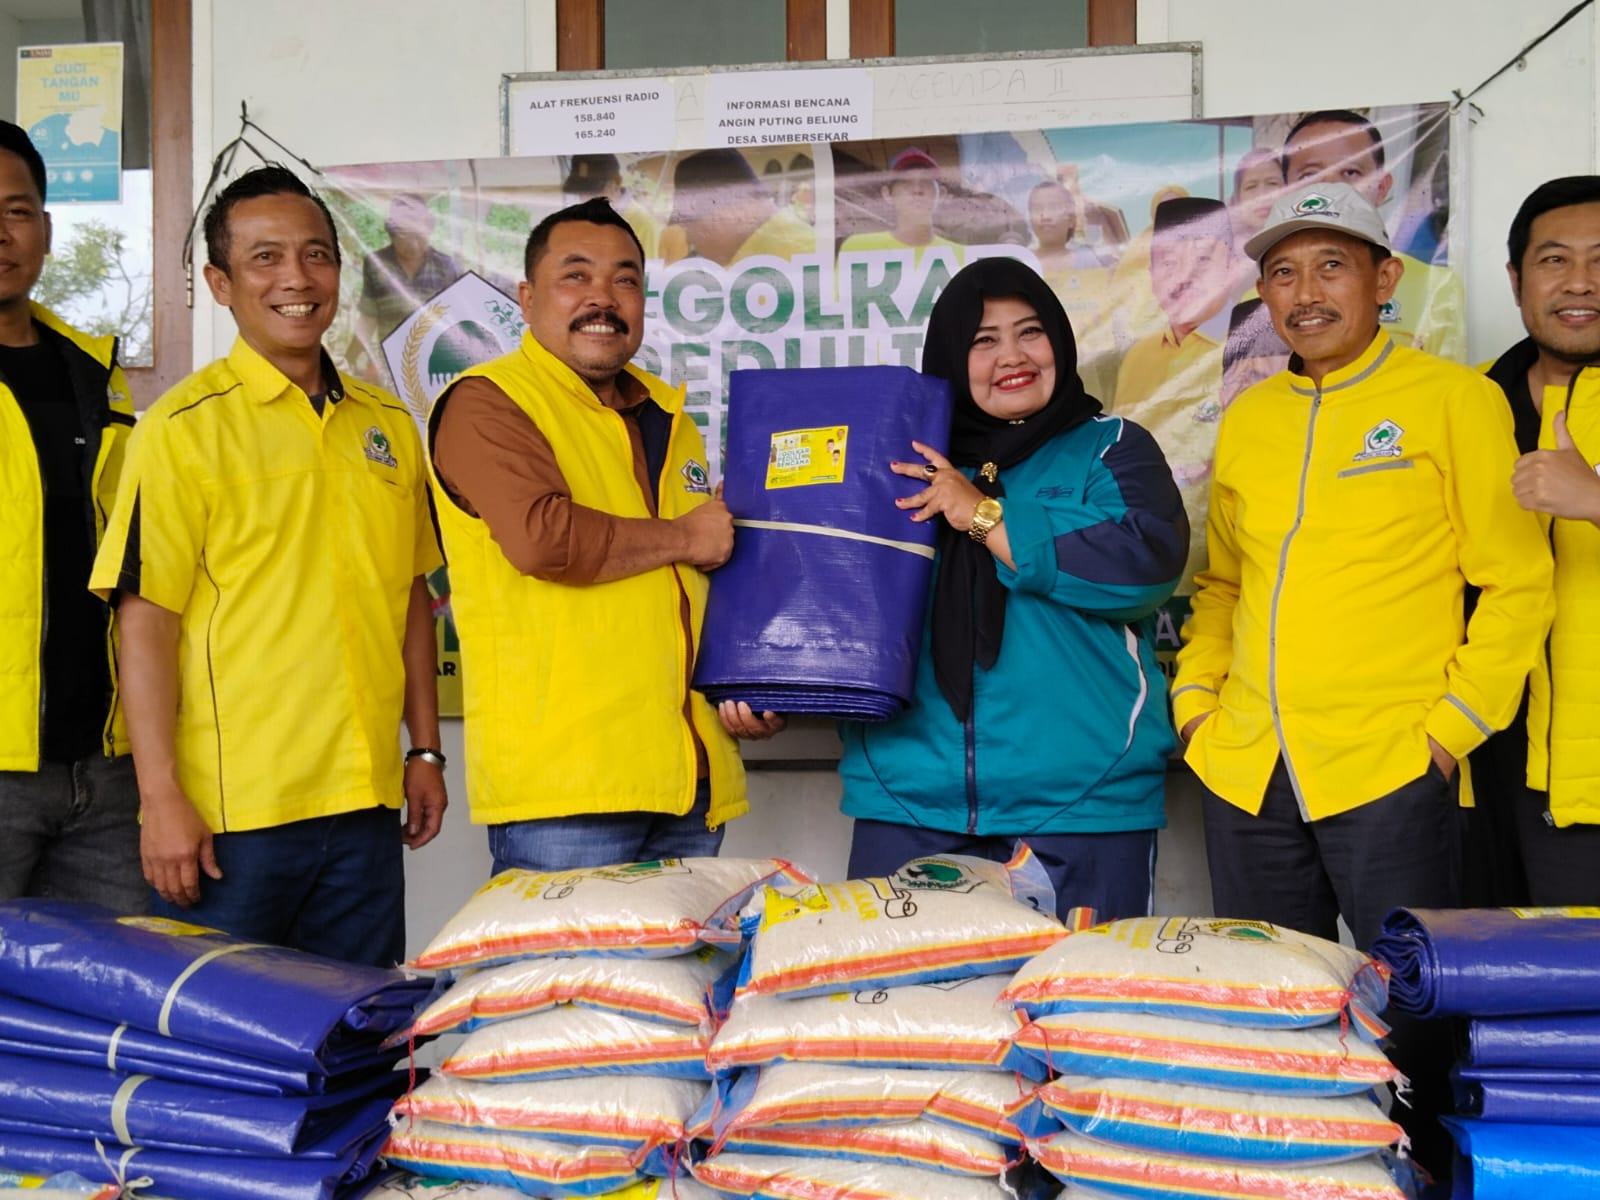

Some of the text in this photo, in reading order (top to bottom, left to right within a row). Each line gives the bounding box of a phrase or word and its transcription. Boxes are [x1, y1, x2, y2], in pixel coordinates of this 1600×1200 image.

[54, 63, 87, 74] CUCI
[41, 76, 99, 88] TANGAN
[58, 91, 80, 102] MU
[530, 92, 660, 110] ALAT FREKUENSI RADIO
[727, 98, 851, 110] INFORMASI BENCANA
[574, 112, 616, 123] 158.840
[718, 114, 859, 128] ANGIN PUTING BELIUNG
[574, 129, 616, 139] 165.240
[727, 132, 849, 144] DESA SUMBERSEKAR
